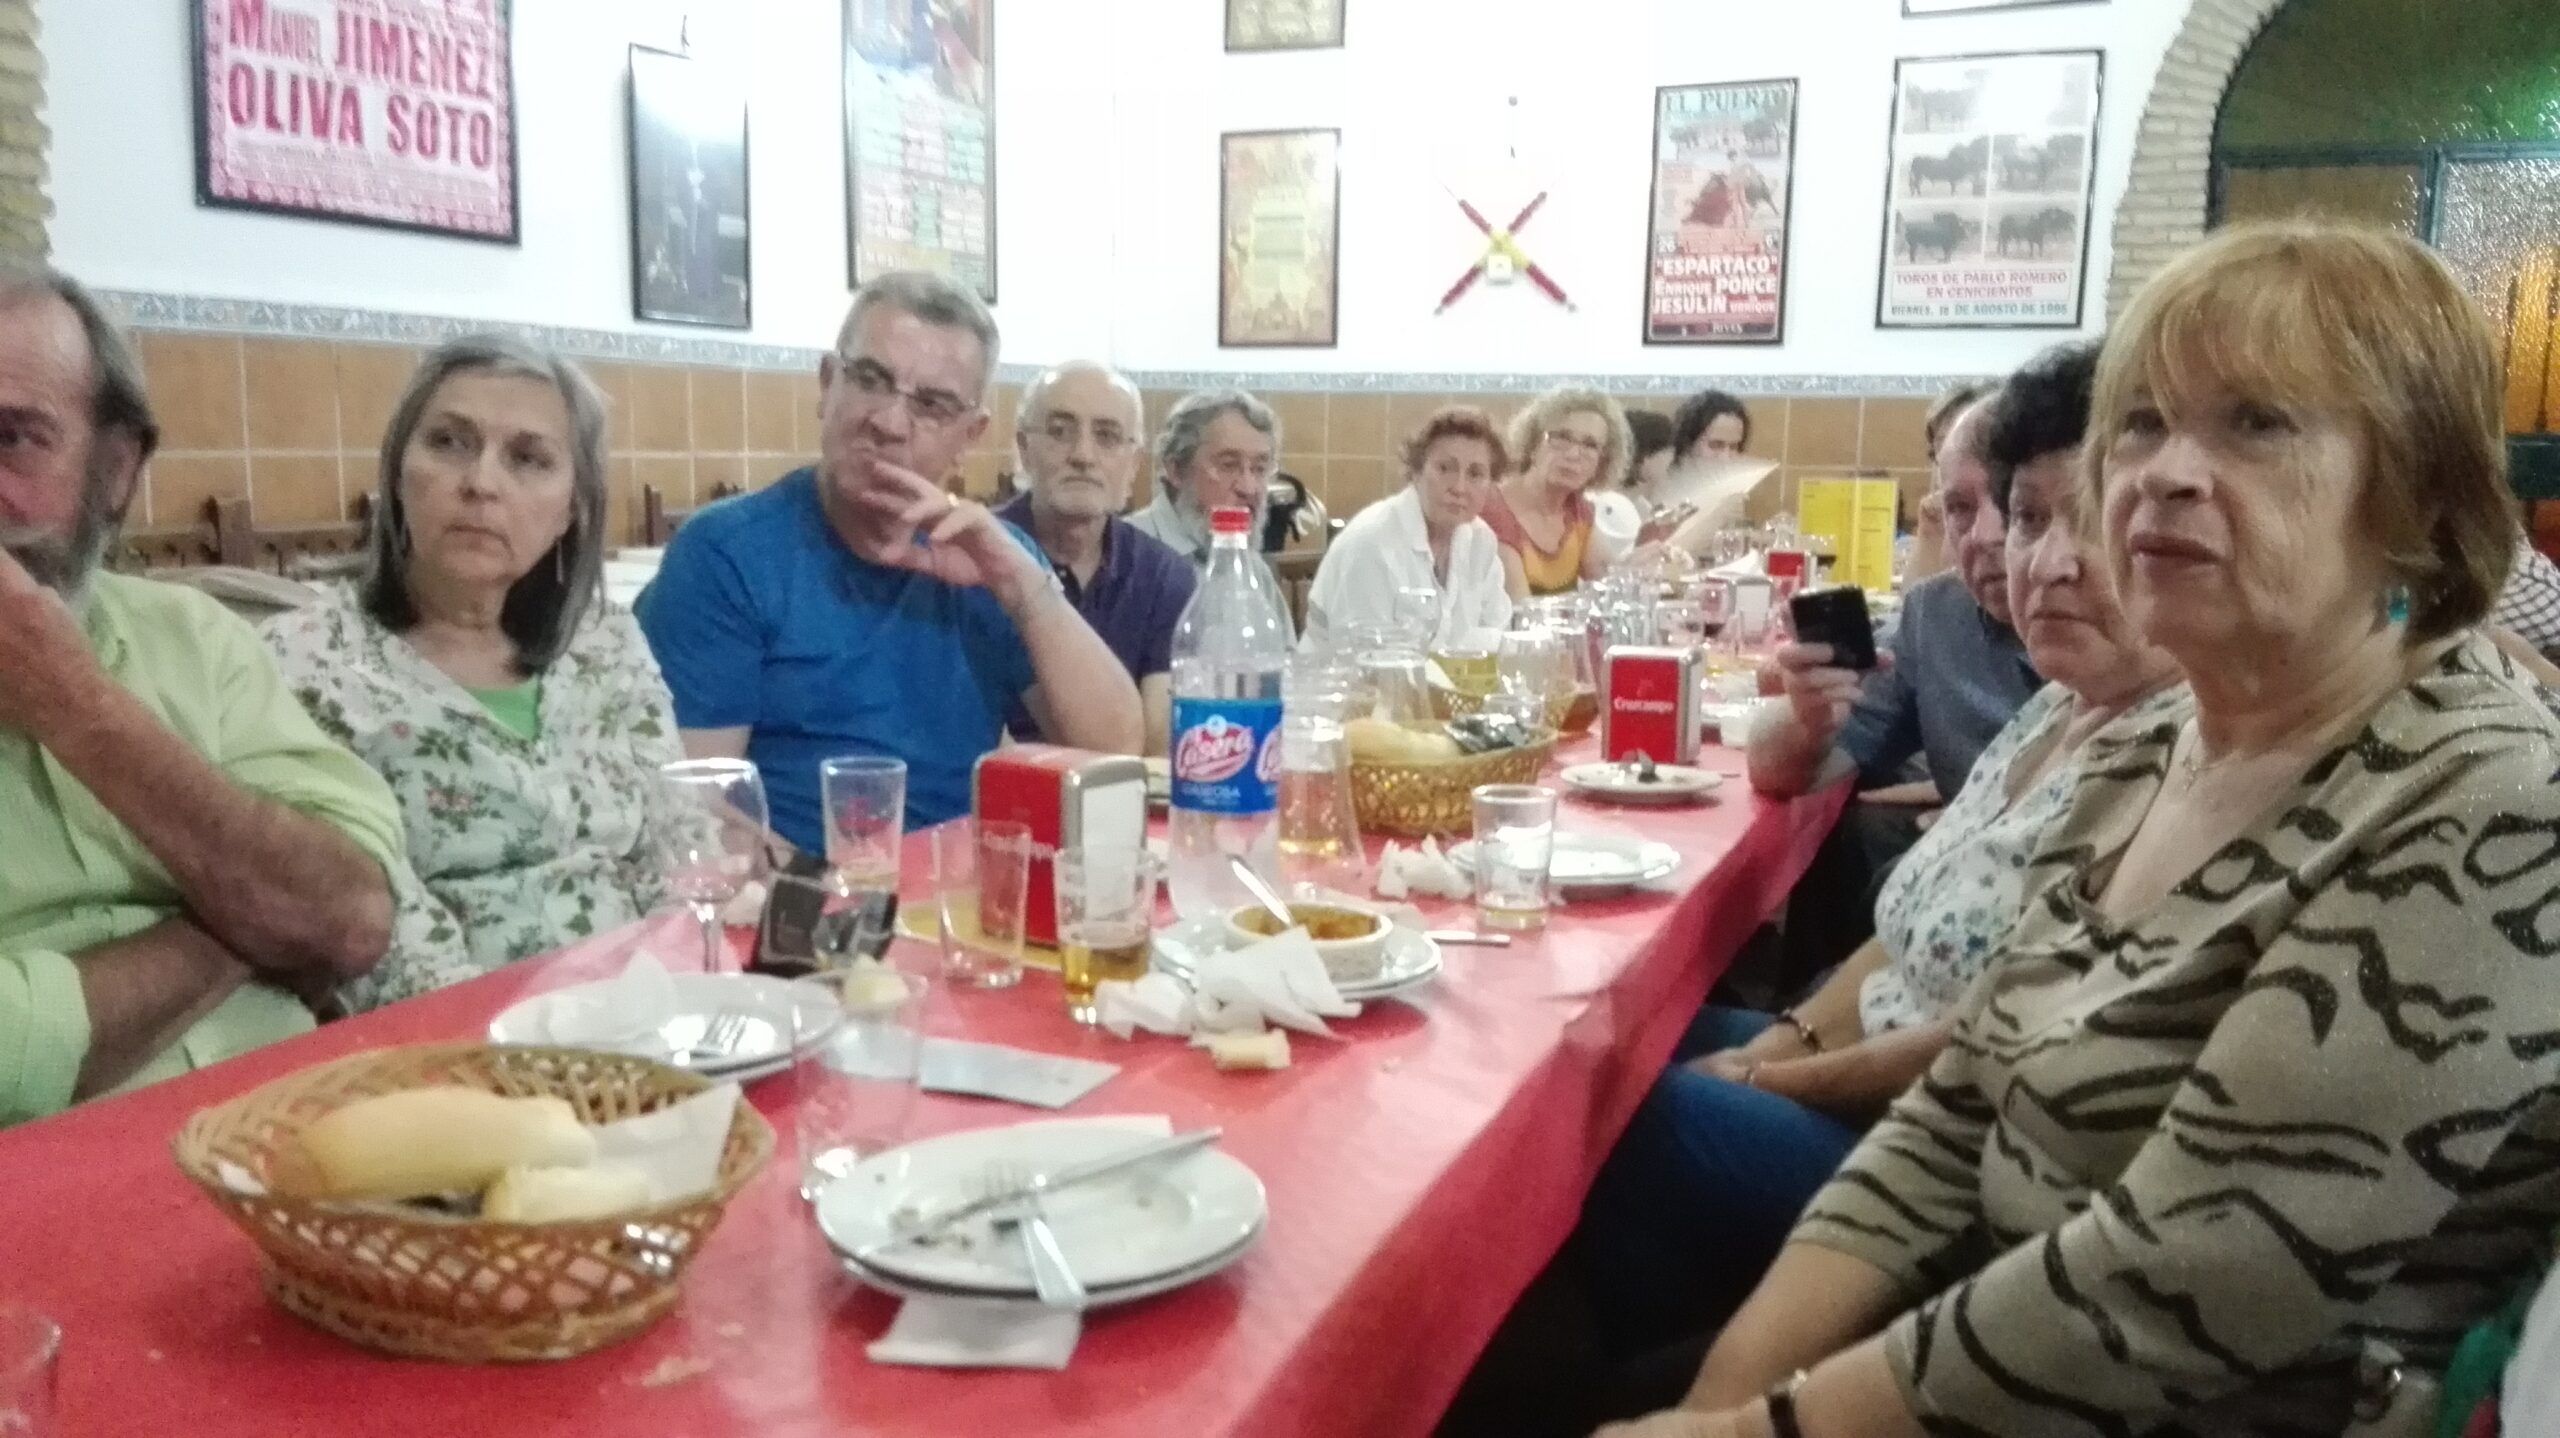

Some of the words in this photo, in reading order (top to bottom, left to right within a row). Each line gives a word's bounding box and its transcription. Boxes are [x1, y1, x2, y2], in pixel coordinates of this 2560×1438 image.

[229, 61, 365, 145] OLIVA
[387, 93, 493, 169] SOTO
[1656, 255, 1778, 276] "ESPARTACO"
[1715, 275, 1777, 295] PONCE
[1897, 272, 1938, 286] TOROS
[1942, 272, 1961, 285] DE
[1963, 271, 2007, 285] PABLO
[2009, 270, 2068, 284] ROMERO
[1926, 286, 1943, 299] EN
[1947, 286, 2033, 299] CENICIENTOS
[1954, 303, 1971, 316] DE
[1973, 302, 2018, 317] AGOSTO
[2021, 302, 2038, 315] DE
